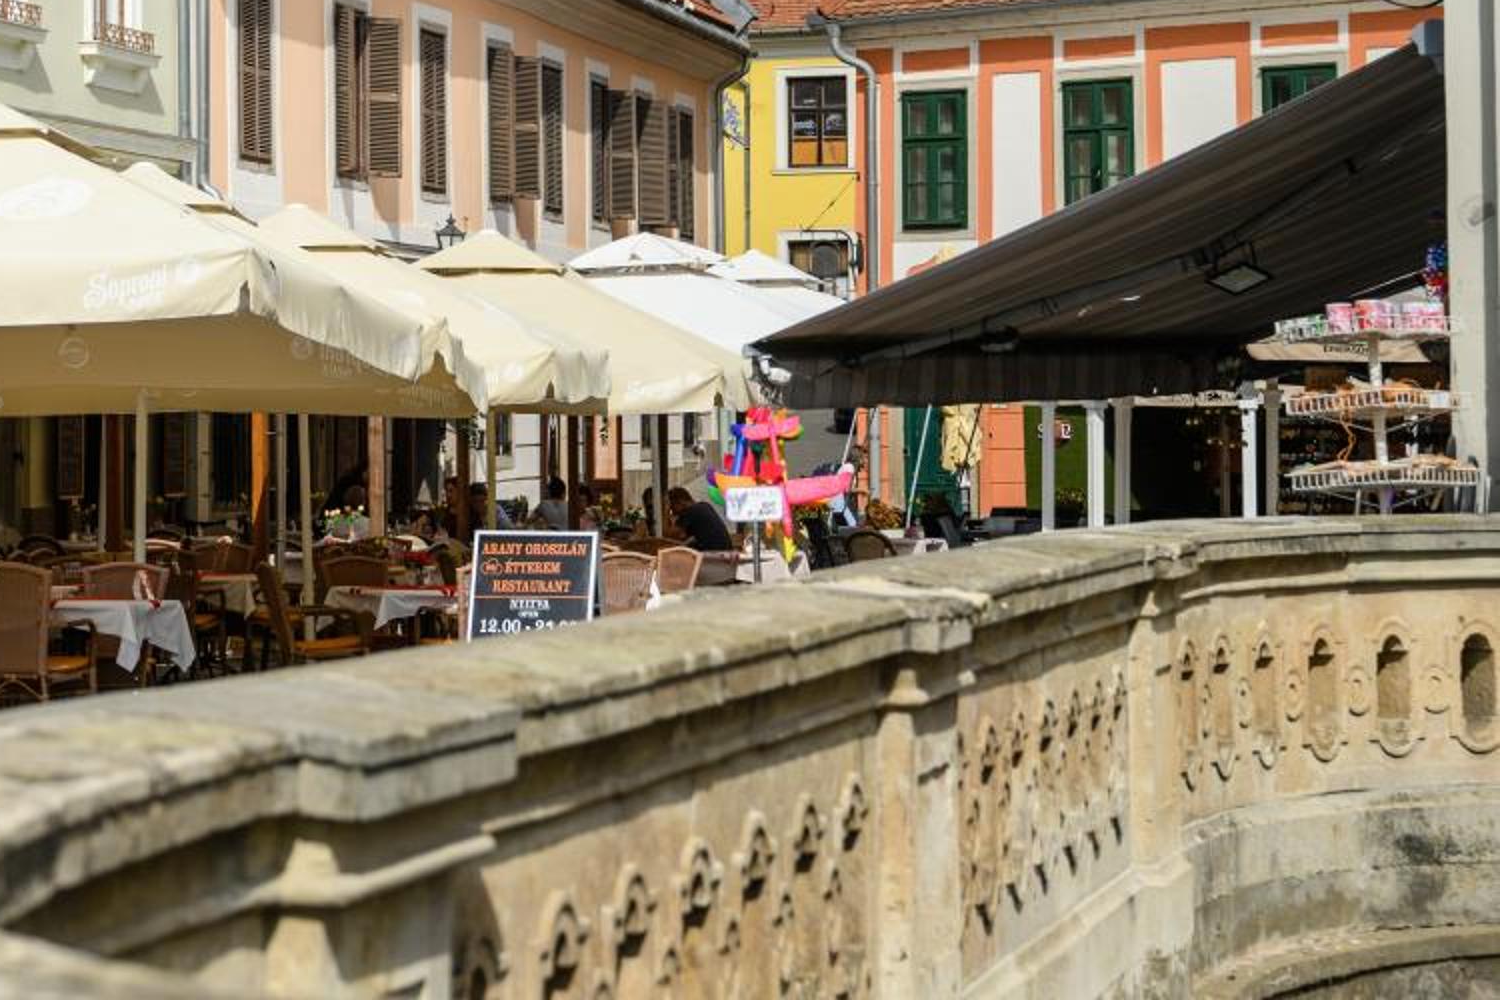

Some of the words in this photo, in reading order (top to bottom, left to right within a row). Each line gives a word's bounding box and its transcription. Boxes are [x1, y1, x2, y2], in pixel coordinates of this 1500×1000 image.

[483, 543, 522, 555] ARANY
[525, 541, 588, 556] OROSZLÁN
[504, 558, 561, 574] ÉTTEREM
[492, 580, 571, 593] RESTAURANT
[479, 619, 521, 634] 12.00
